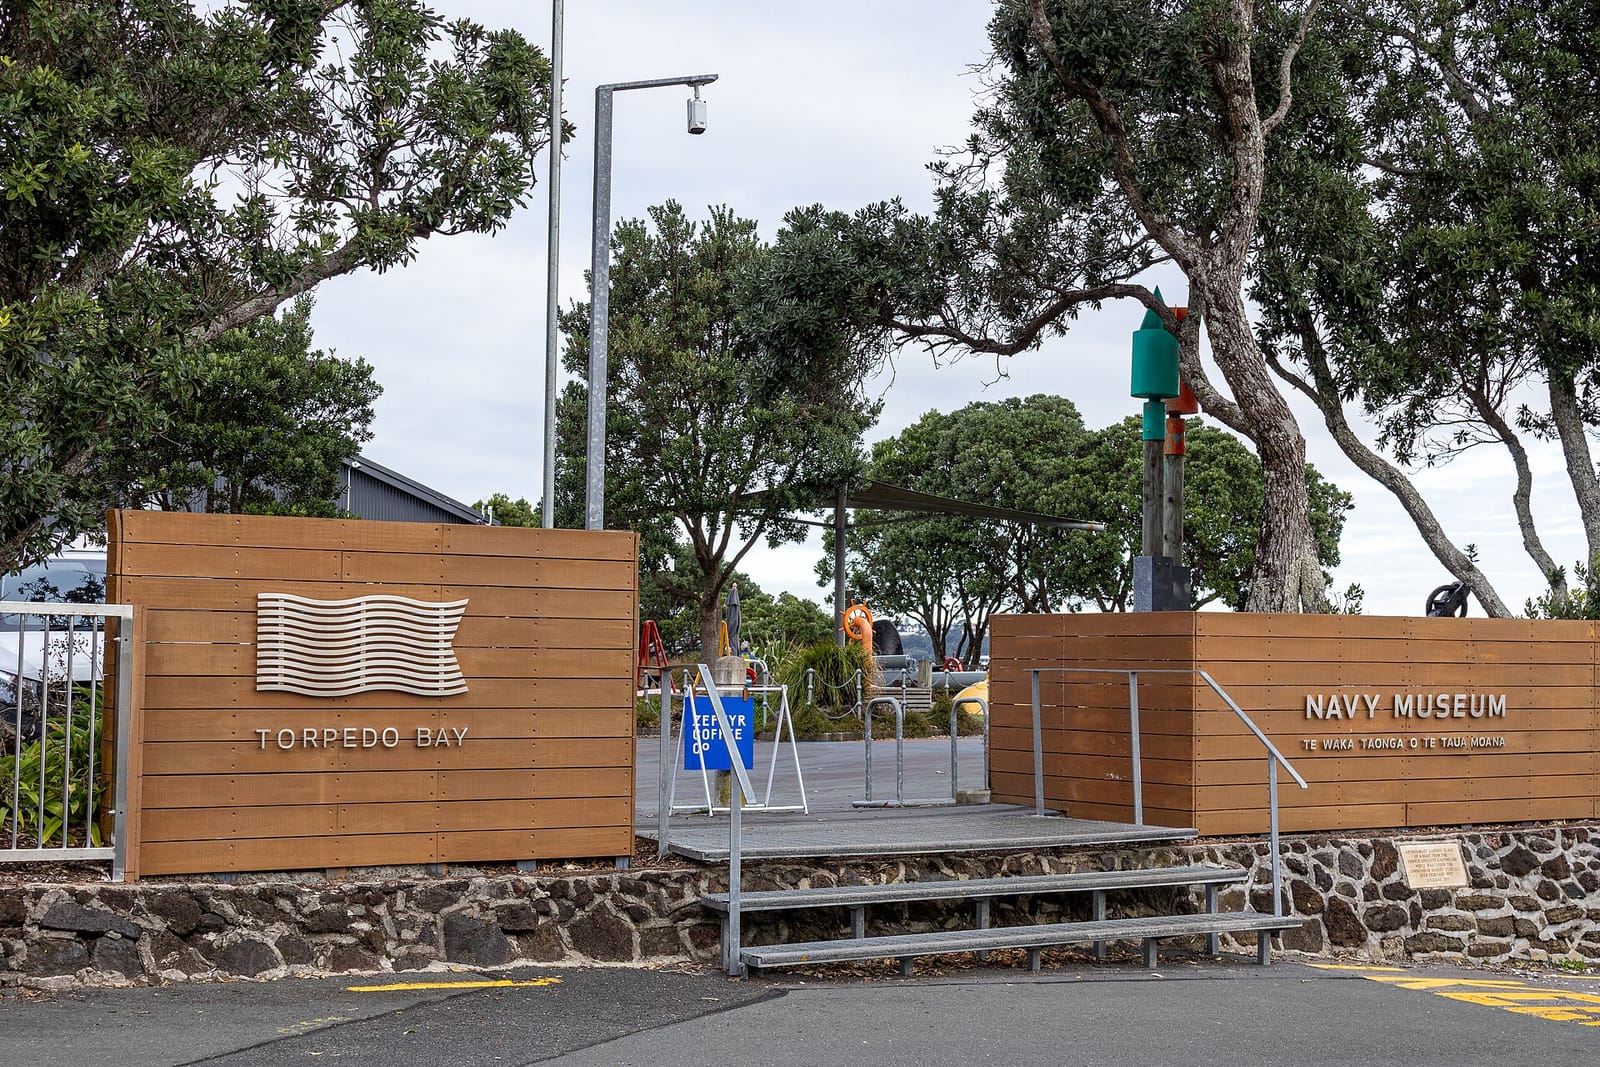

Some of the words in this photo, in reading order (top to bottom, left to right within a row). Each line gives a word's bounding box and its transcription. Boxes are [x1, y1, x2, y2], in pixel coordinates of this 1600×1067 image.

[1306, 694, 1381, 719] NAVY
[1394, 693, 1506, 718] MUSEUM
[692, 714, 747, 727] ZEPYR
[256, 727, 399, 749] TORPEDO
[416, 727, 468, 747] BAY
[1303, 739, 1317, 750] TE
[1323, 738, 1354, 750] WAKA
[1361, 738, 1403, 749] TAONGA
[1410, 737, 1418, 748] O
[1424, 737, 1436, 748] TE
[1441, 737, 1467, 748] TAUA
[1470, 736, 1505, 748] MOANA
